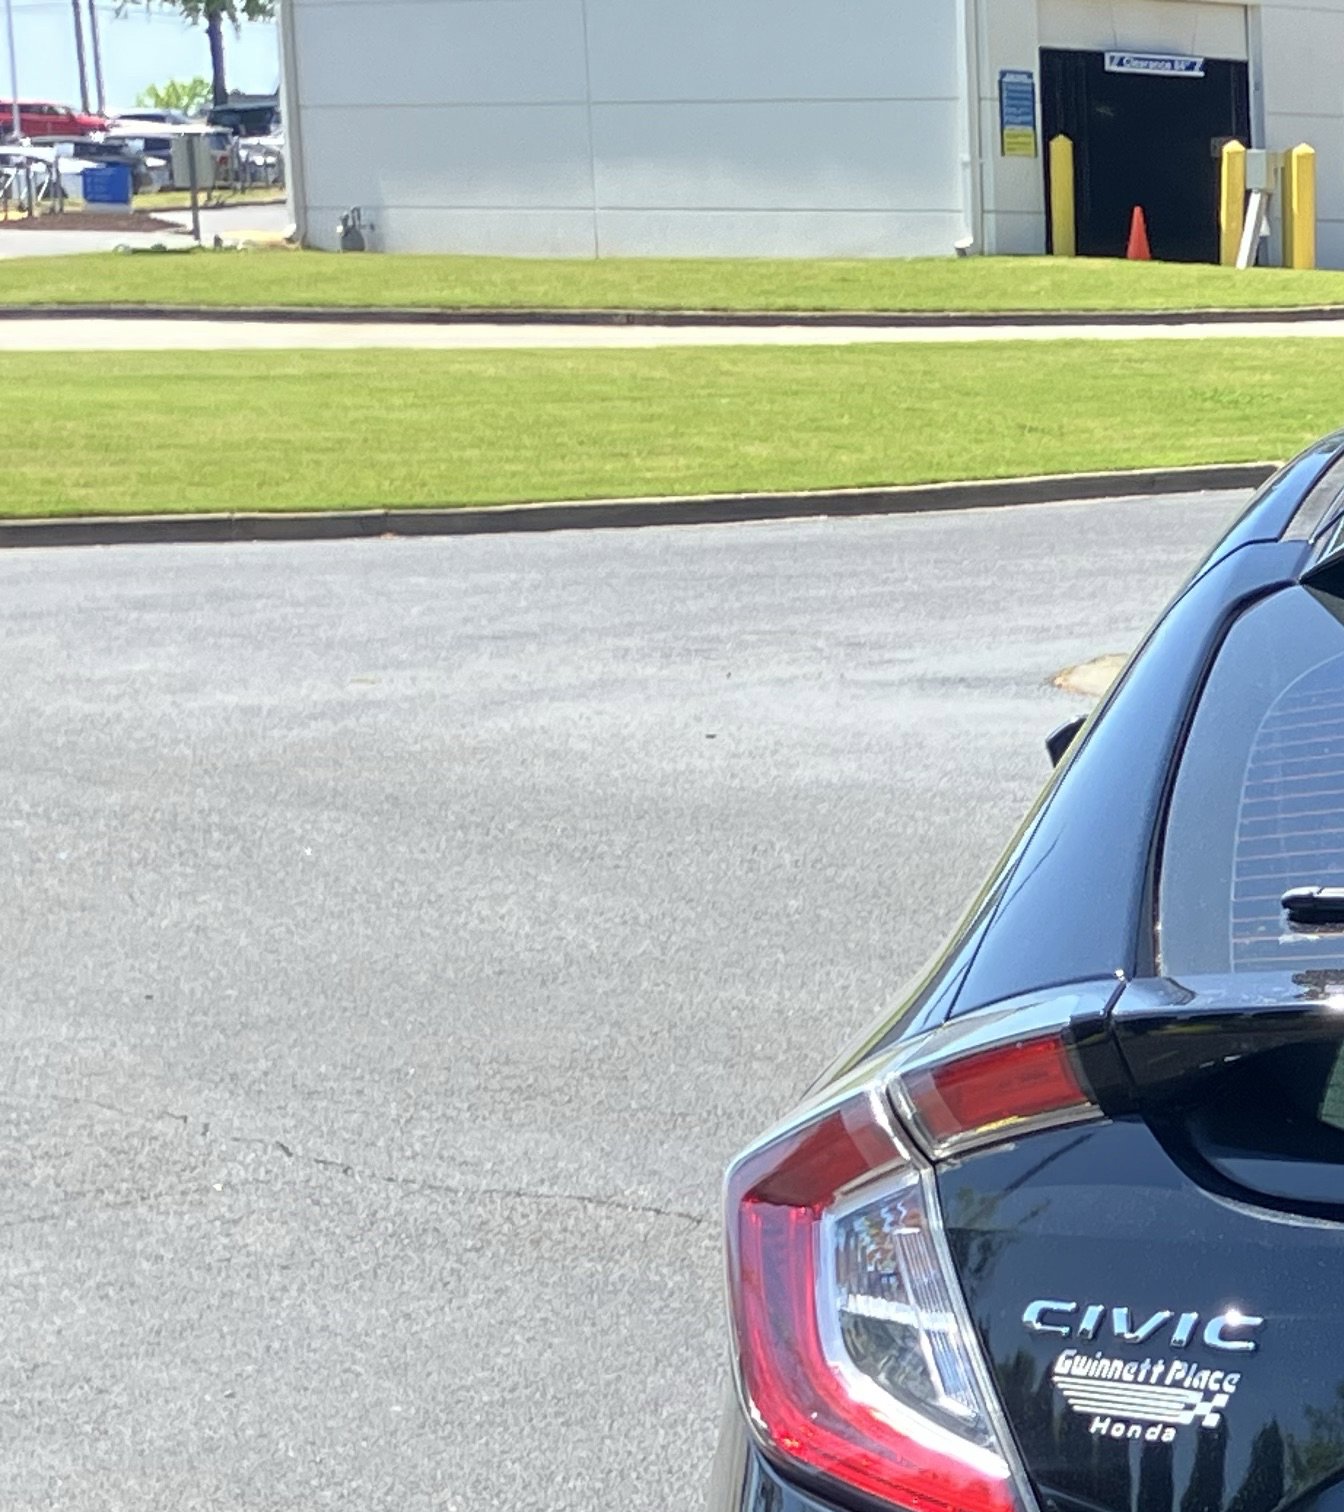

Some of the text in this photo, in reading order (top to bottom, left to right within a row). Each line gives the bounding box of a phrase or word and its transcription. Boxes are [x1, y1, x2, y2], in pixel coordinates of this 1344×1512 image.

[1022, 1300, 1264, 1351] CIVIC
[1053, 1350, 1241, 1393] Gwinnett Place
[1090, 1416, 1176, 1442] Honda
